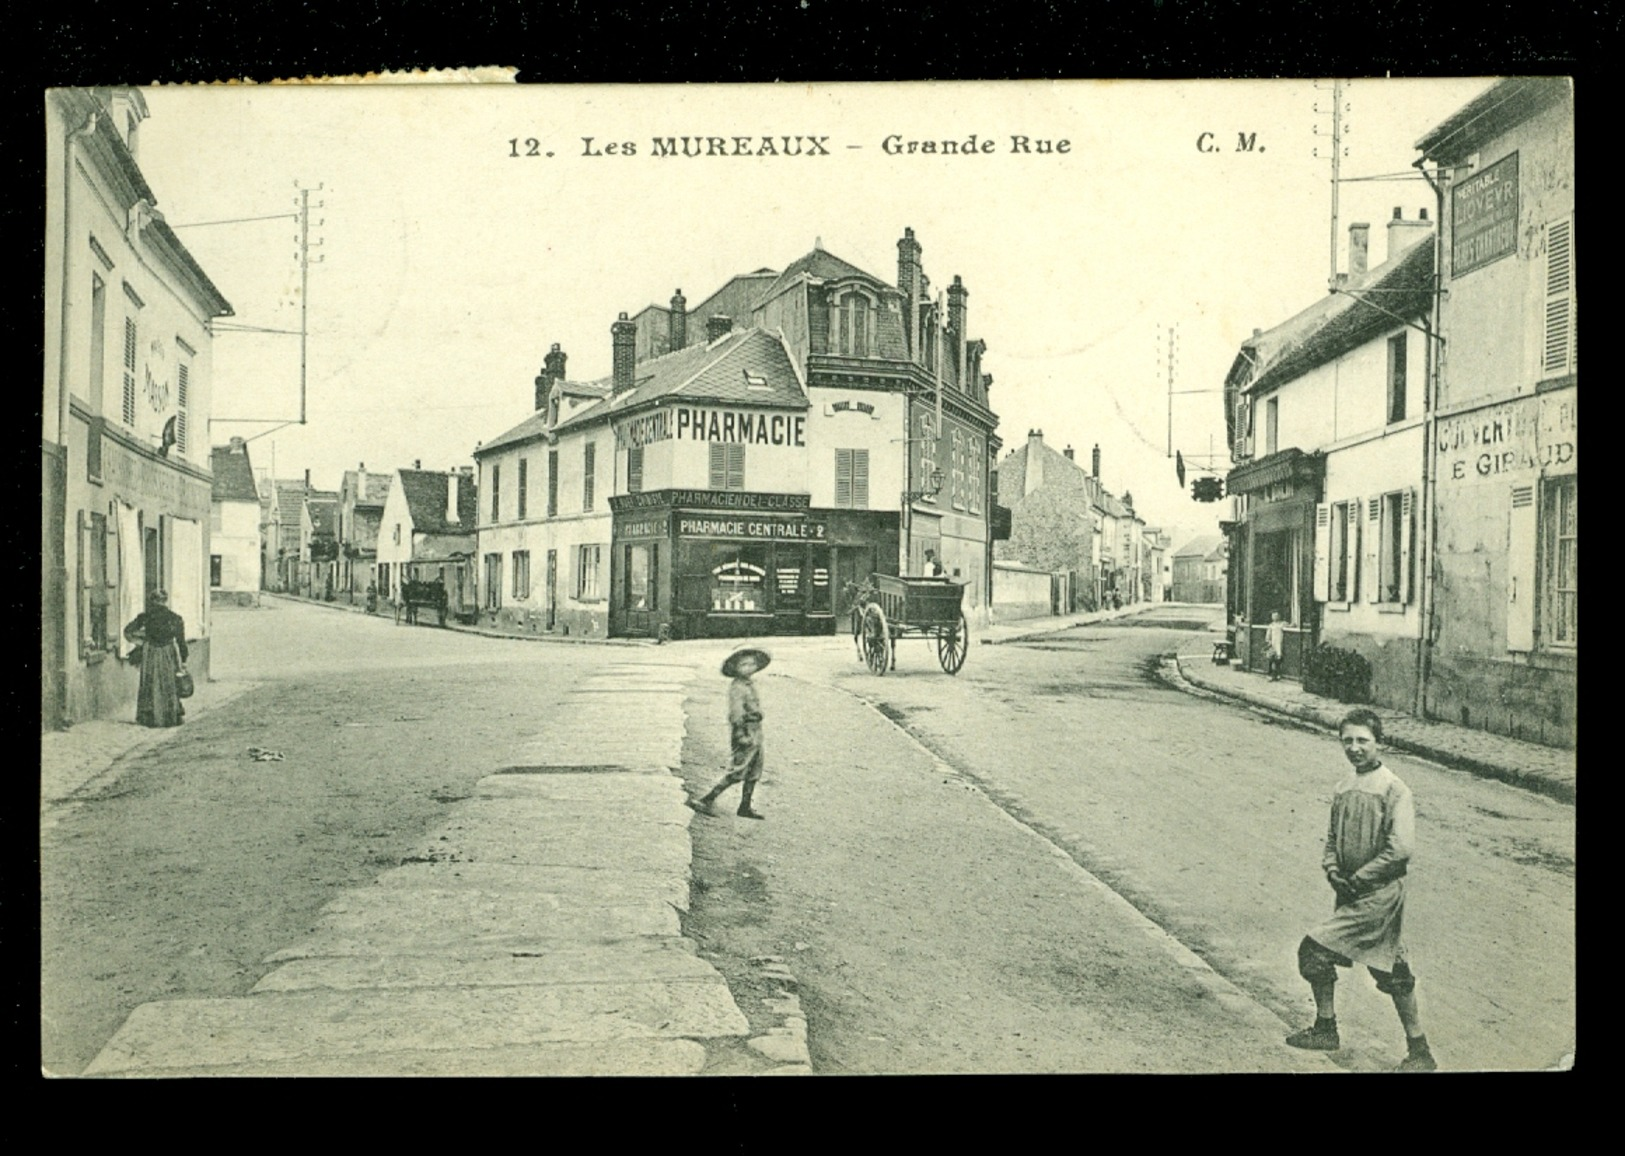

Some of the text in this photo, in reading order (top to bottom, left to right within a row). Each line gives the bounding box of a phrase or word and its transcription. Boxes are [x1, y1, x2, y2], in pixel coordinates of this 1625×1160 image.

[677, 408, 806, 447] PHARMACIE
[670, 491, 740, 507] PHARMACIEN
[768, 496, 808, 509] CLASSE
[680, 519, 745, 536] PHARMACIE
[748, 521, 808, 538] CENTRALE
